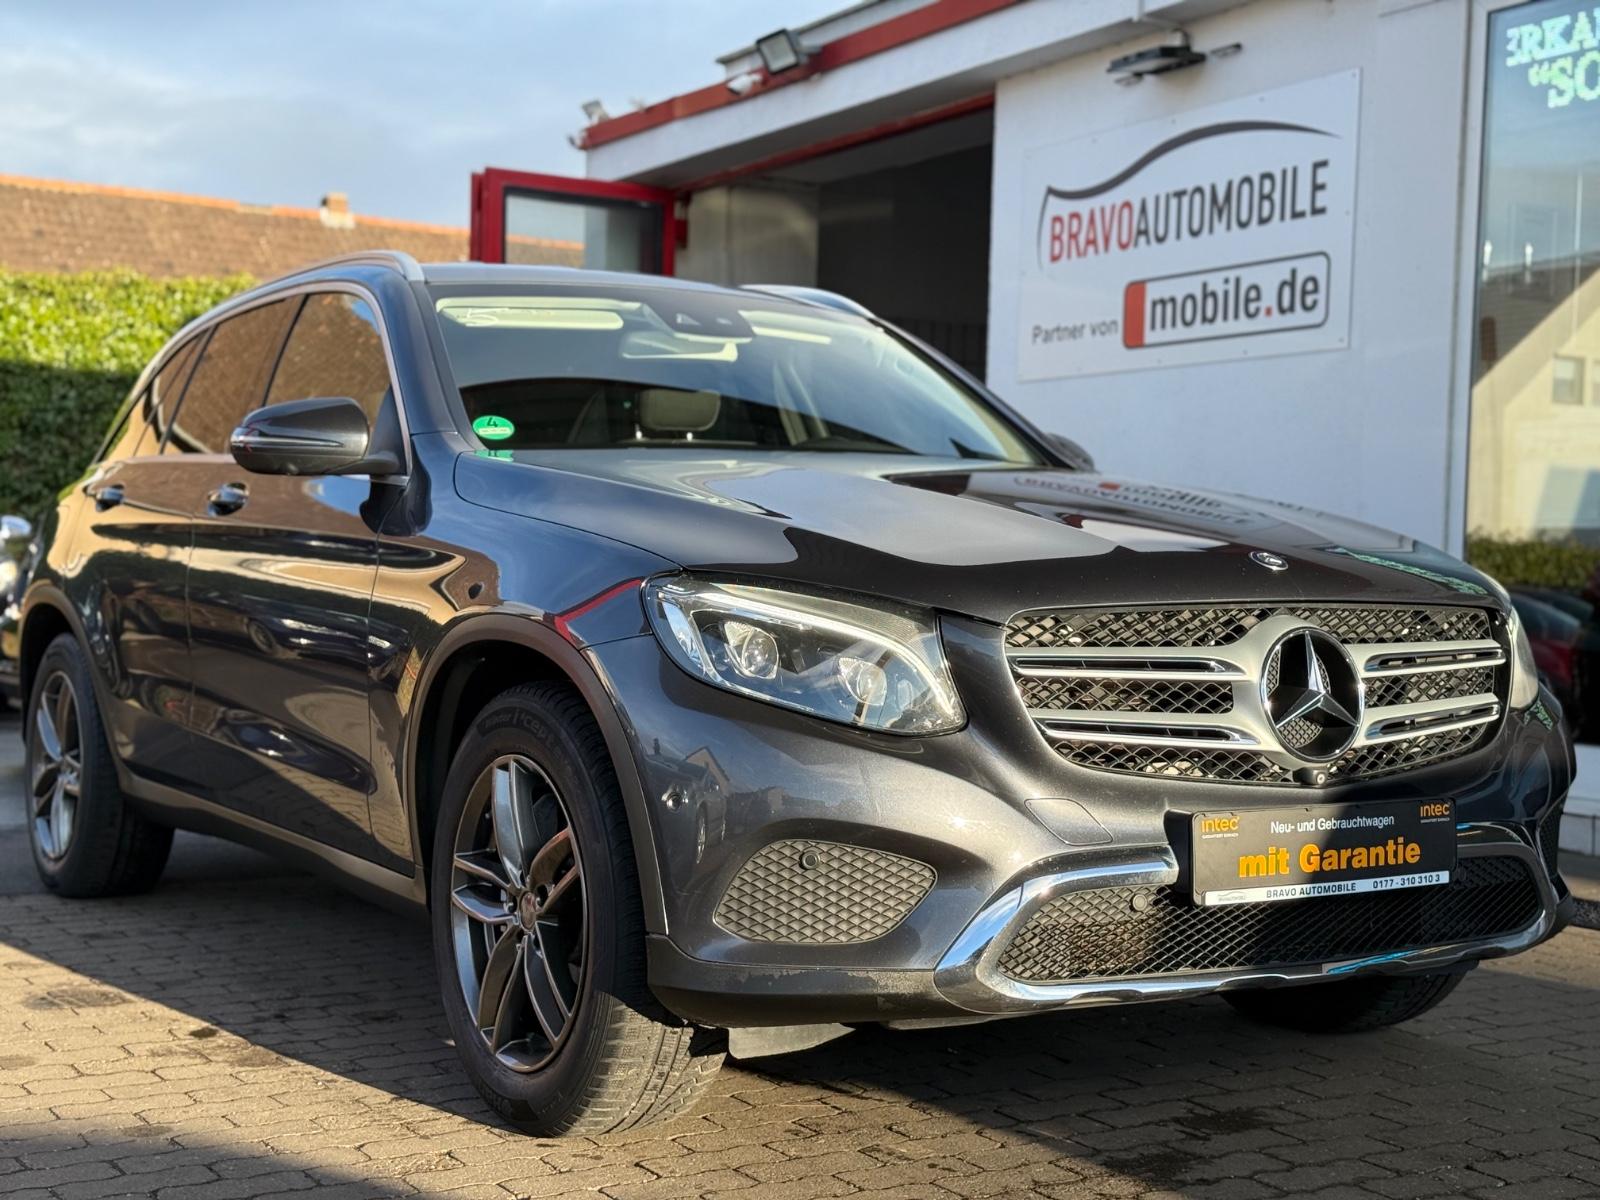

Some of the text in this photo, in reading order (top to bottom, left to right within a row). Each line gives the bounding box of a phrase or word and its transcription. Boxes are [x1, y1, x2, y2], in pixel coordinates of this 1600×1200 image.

[1149, 267, 1320, 332] mobile.de
[1031, 318, 1119, 345] Partner von
[486, 416, 499, 428] 4
[1420, 803, 1451, 818] intec
[1201, 816, 1240, 833] intec
[1270, 815, 1395, 834] Neu- und Gebrauchtwagen
[1239, 836, 1421, 878] mit Garantie
[1266, 887, 1297, 899] BRAVO
[1299, 882, 1357, 896] AUTOMOBILE
